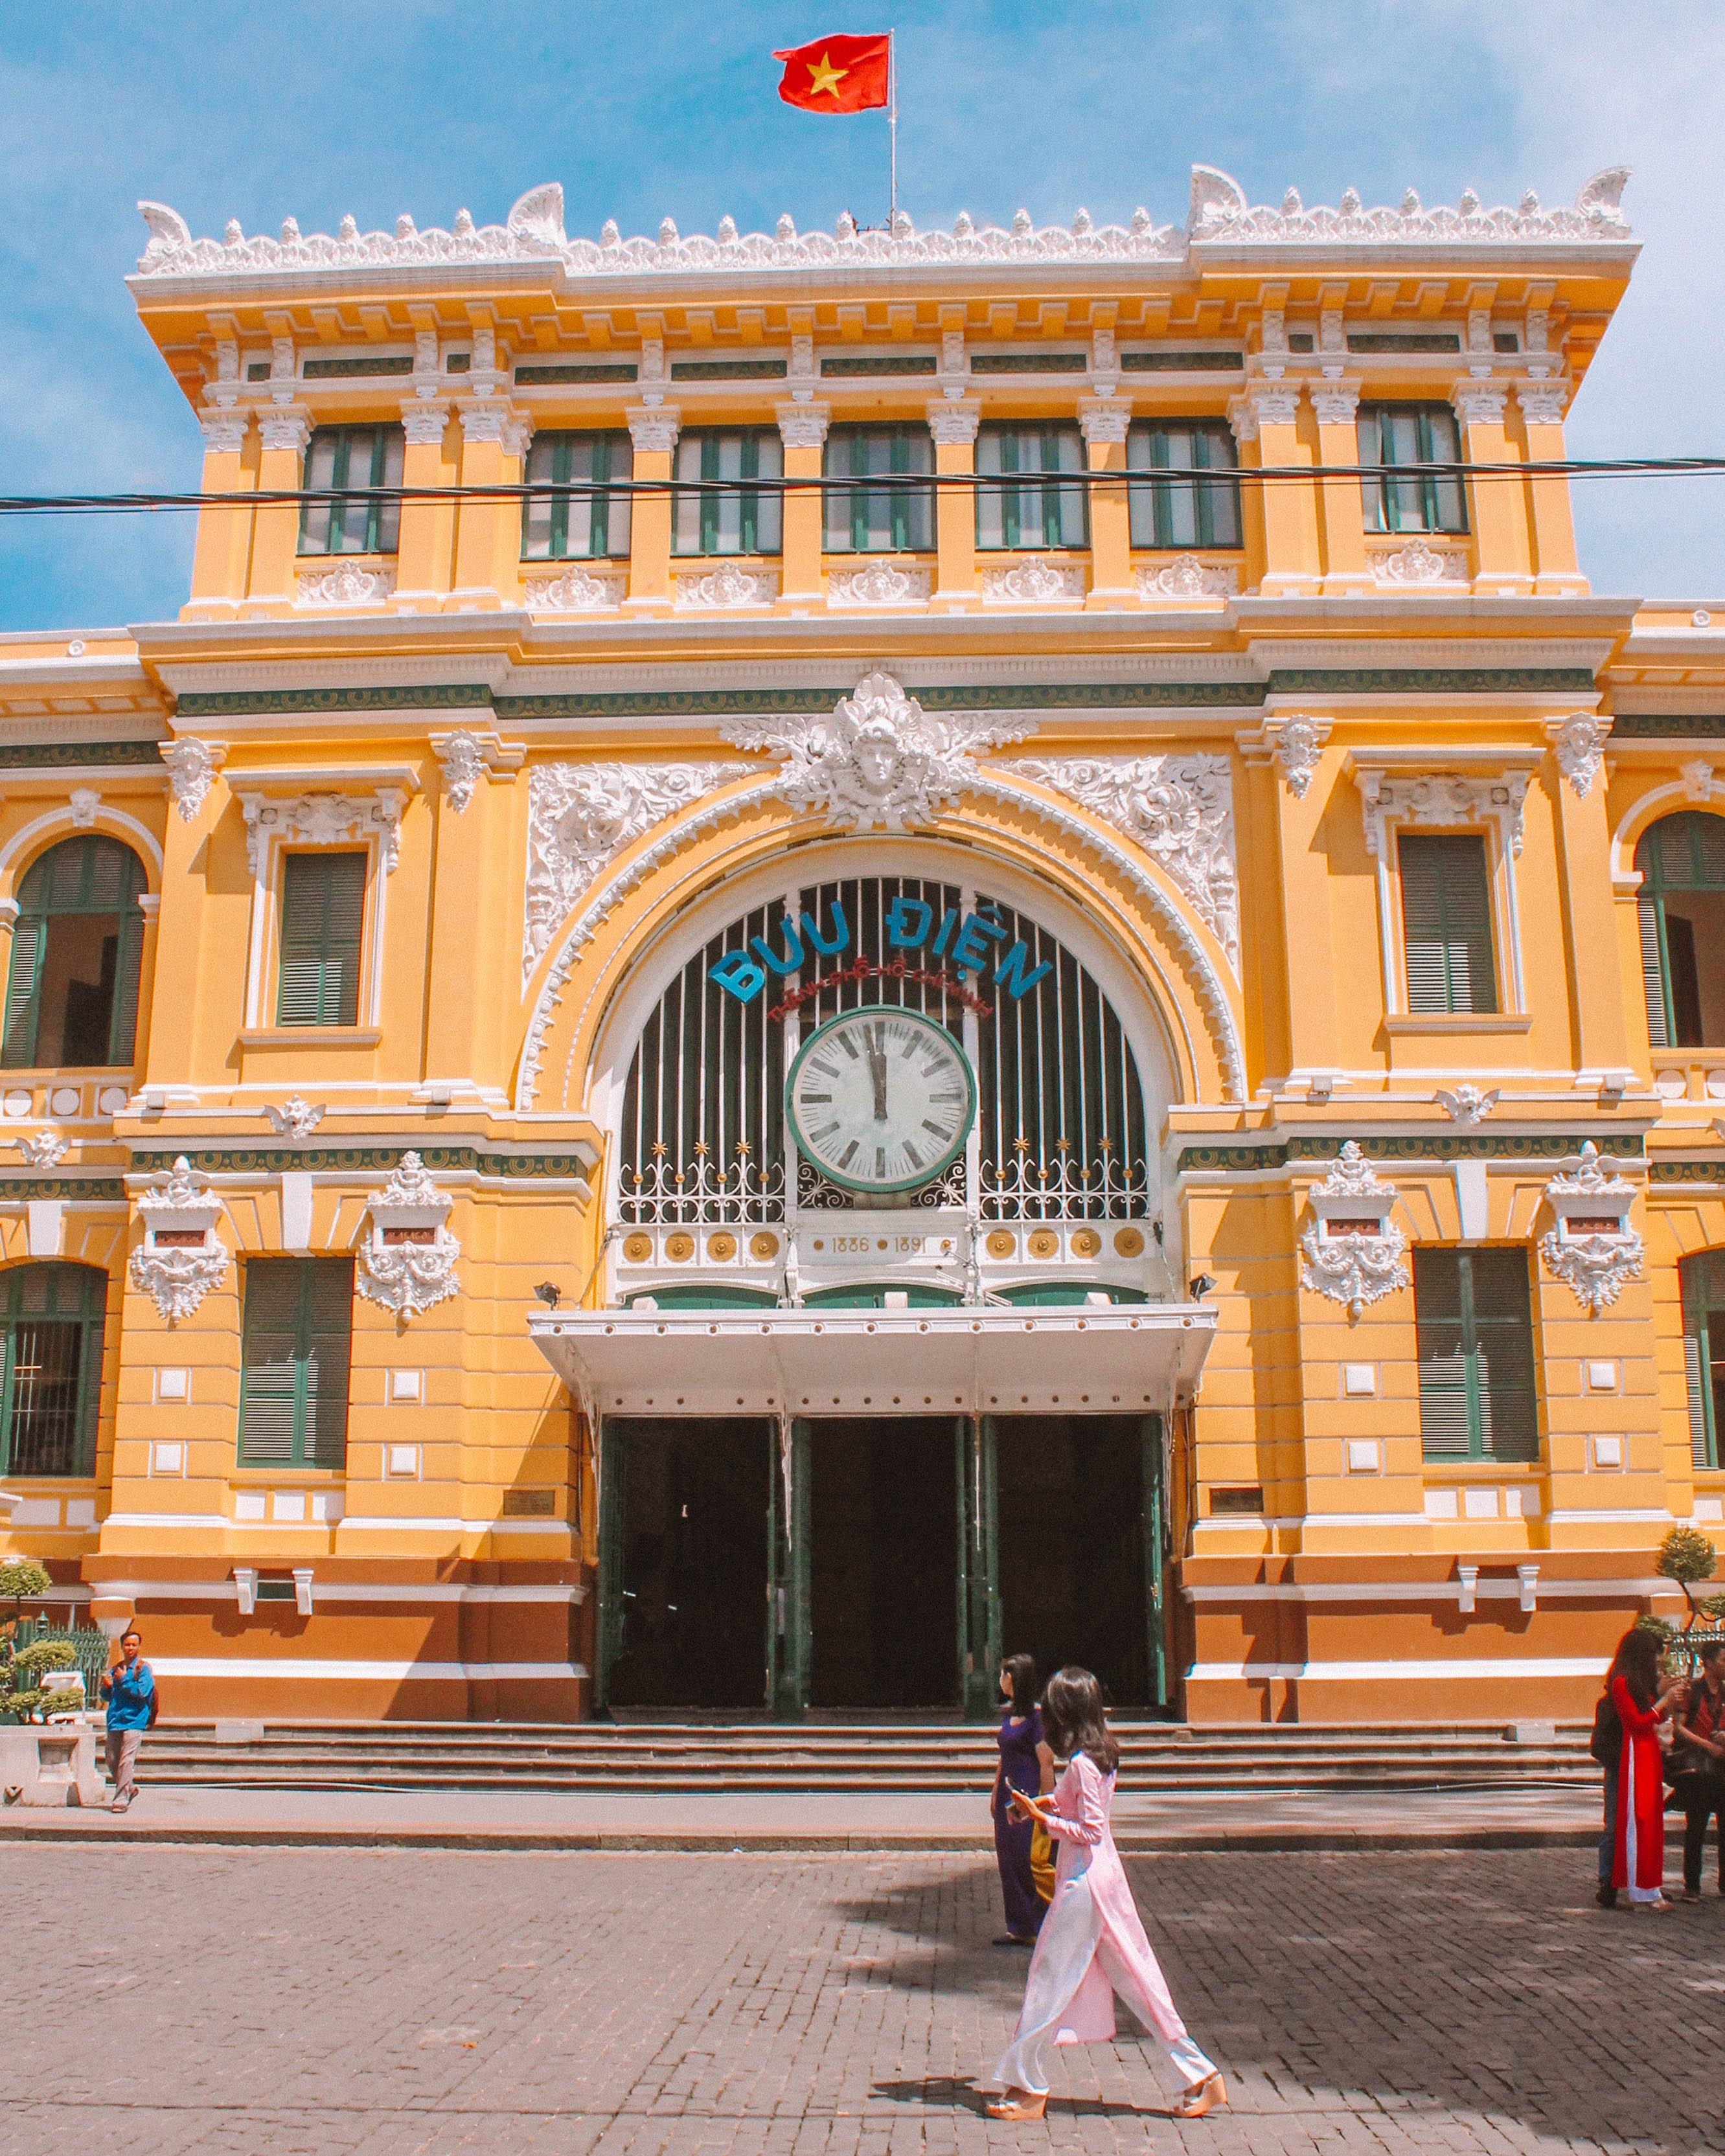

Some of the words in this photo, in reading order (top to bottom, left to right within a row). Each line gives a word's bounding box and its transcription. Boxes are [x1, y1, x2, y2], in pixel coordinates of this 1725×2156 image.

[885, 896, 1053, 1000] ĐIỆN
[832, 1237, 869, 1253] 1886
[895, 1236, 926, 1253] 1891
